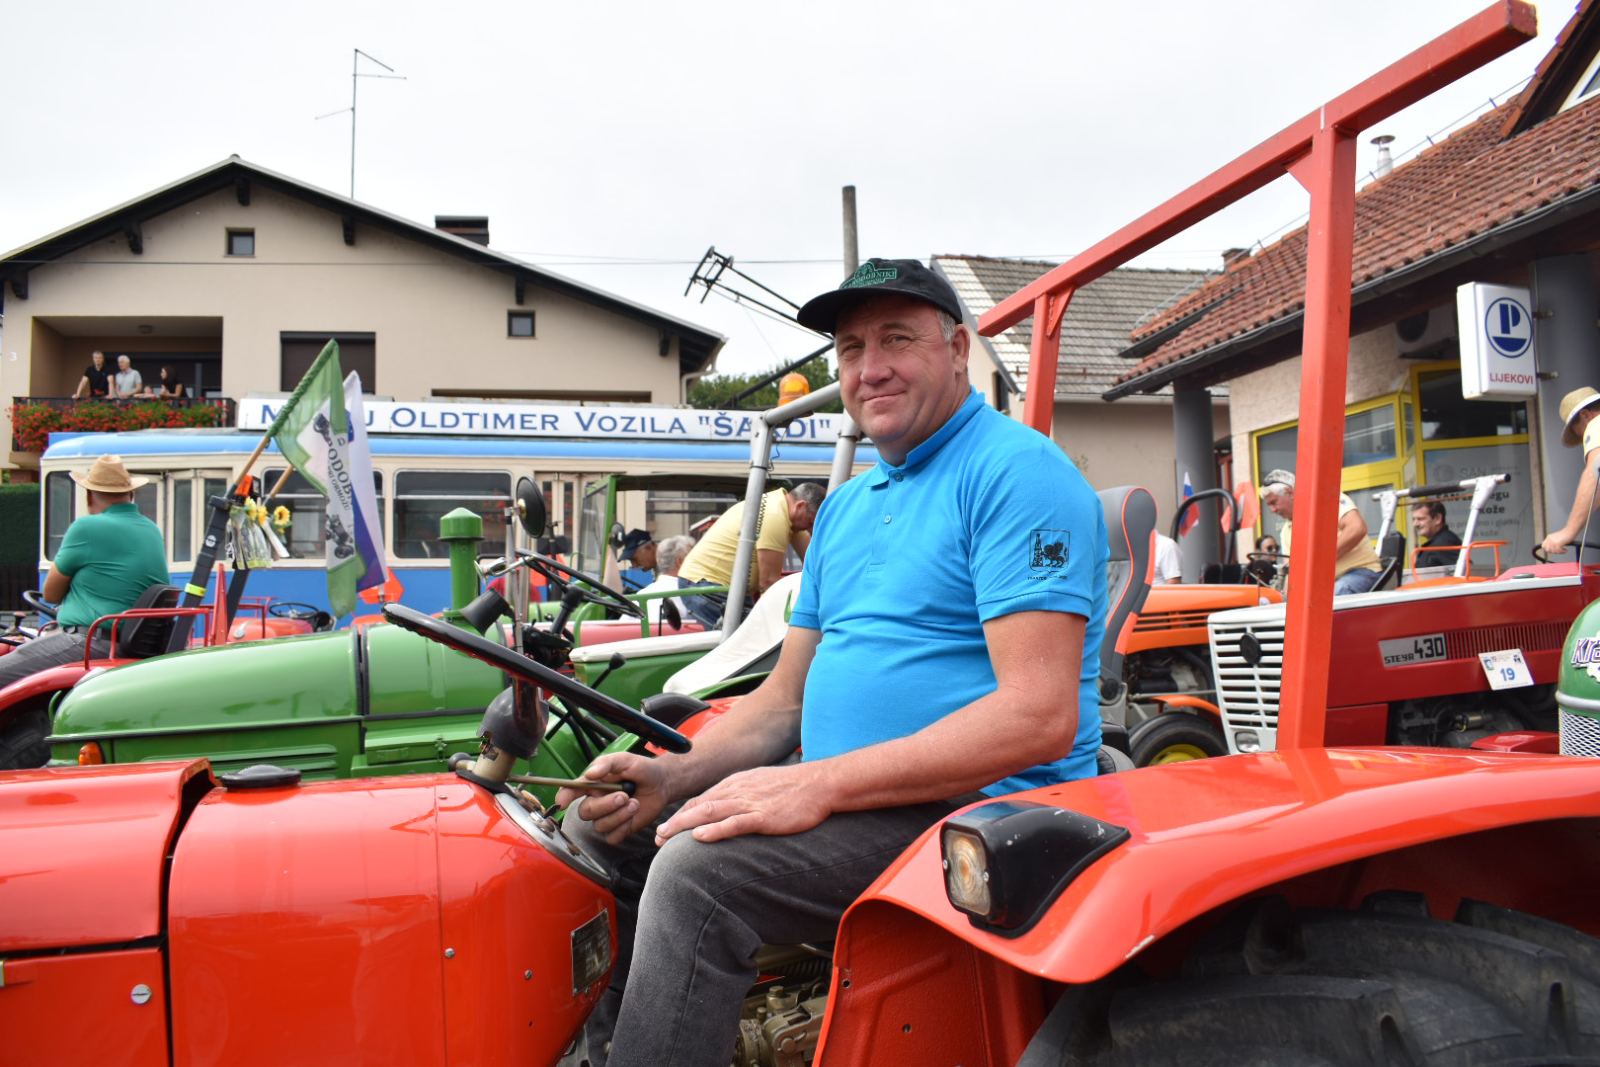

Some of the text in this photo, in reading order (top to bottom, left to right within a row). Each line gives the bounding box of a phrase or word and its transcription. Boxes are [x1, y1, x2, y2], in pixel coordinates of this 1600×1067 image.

[1489, 372, 1534, 384] LIJEKOVI
[391, 407, 559, 430] OLDTIMER
[575, 411, 687, 434] VOZILA
[698, 412, 830, 438] "ŠADI"
[1414, 637, 1445, 659] 430
[1500, 667, 1515, 681] 19
